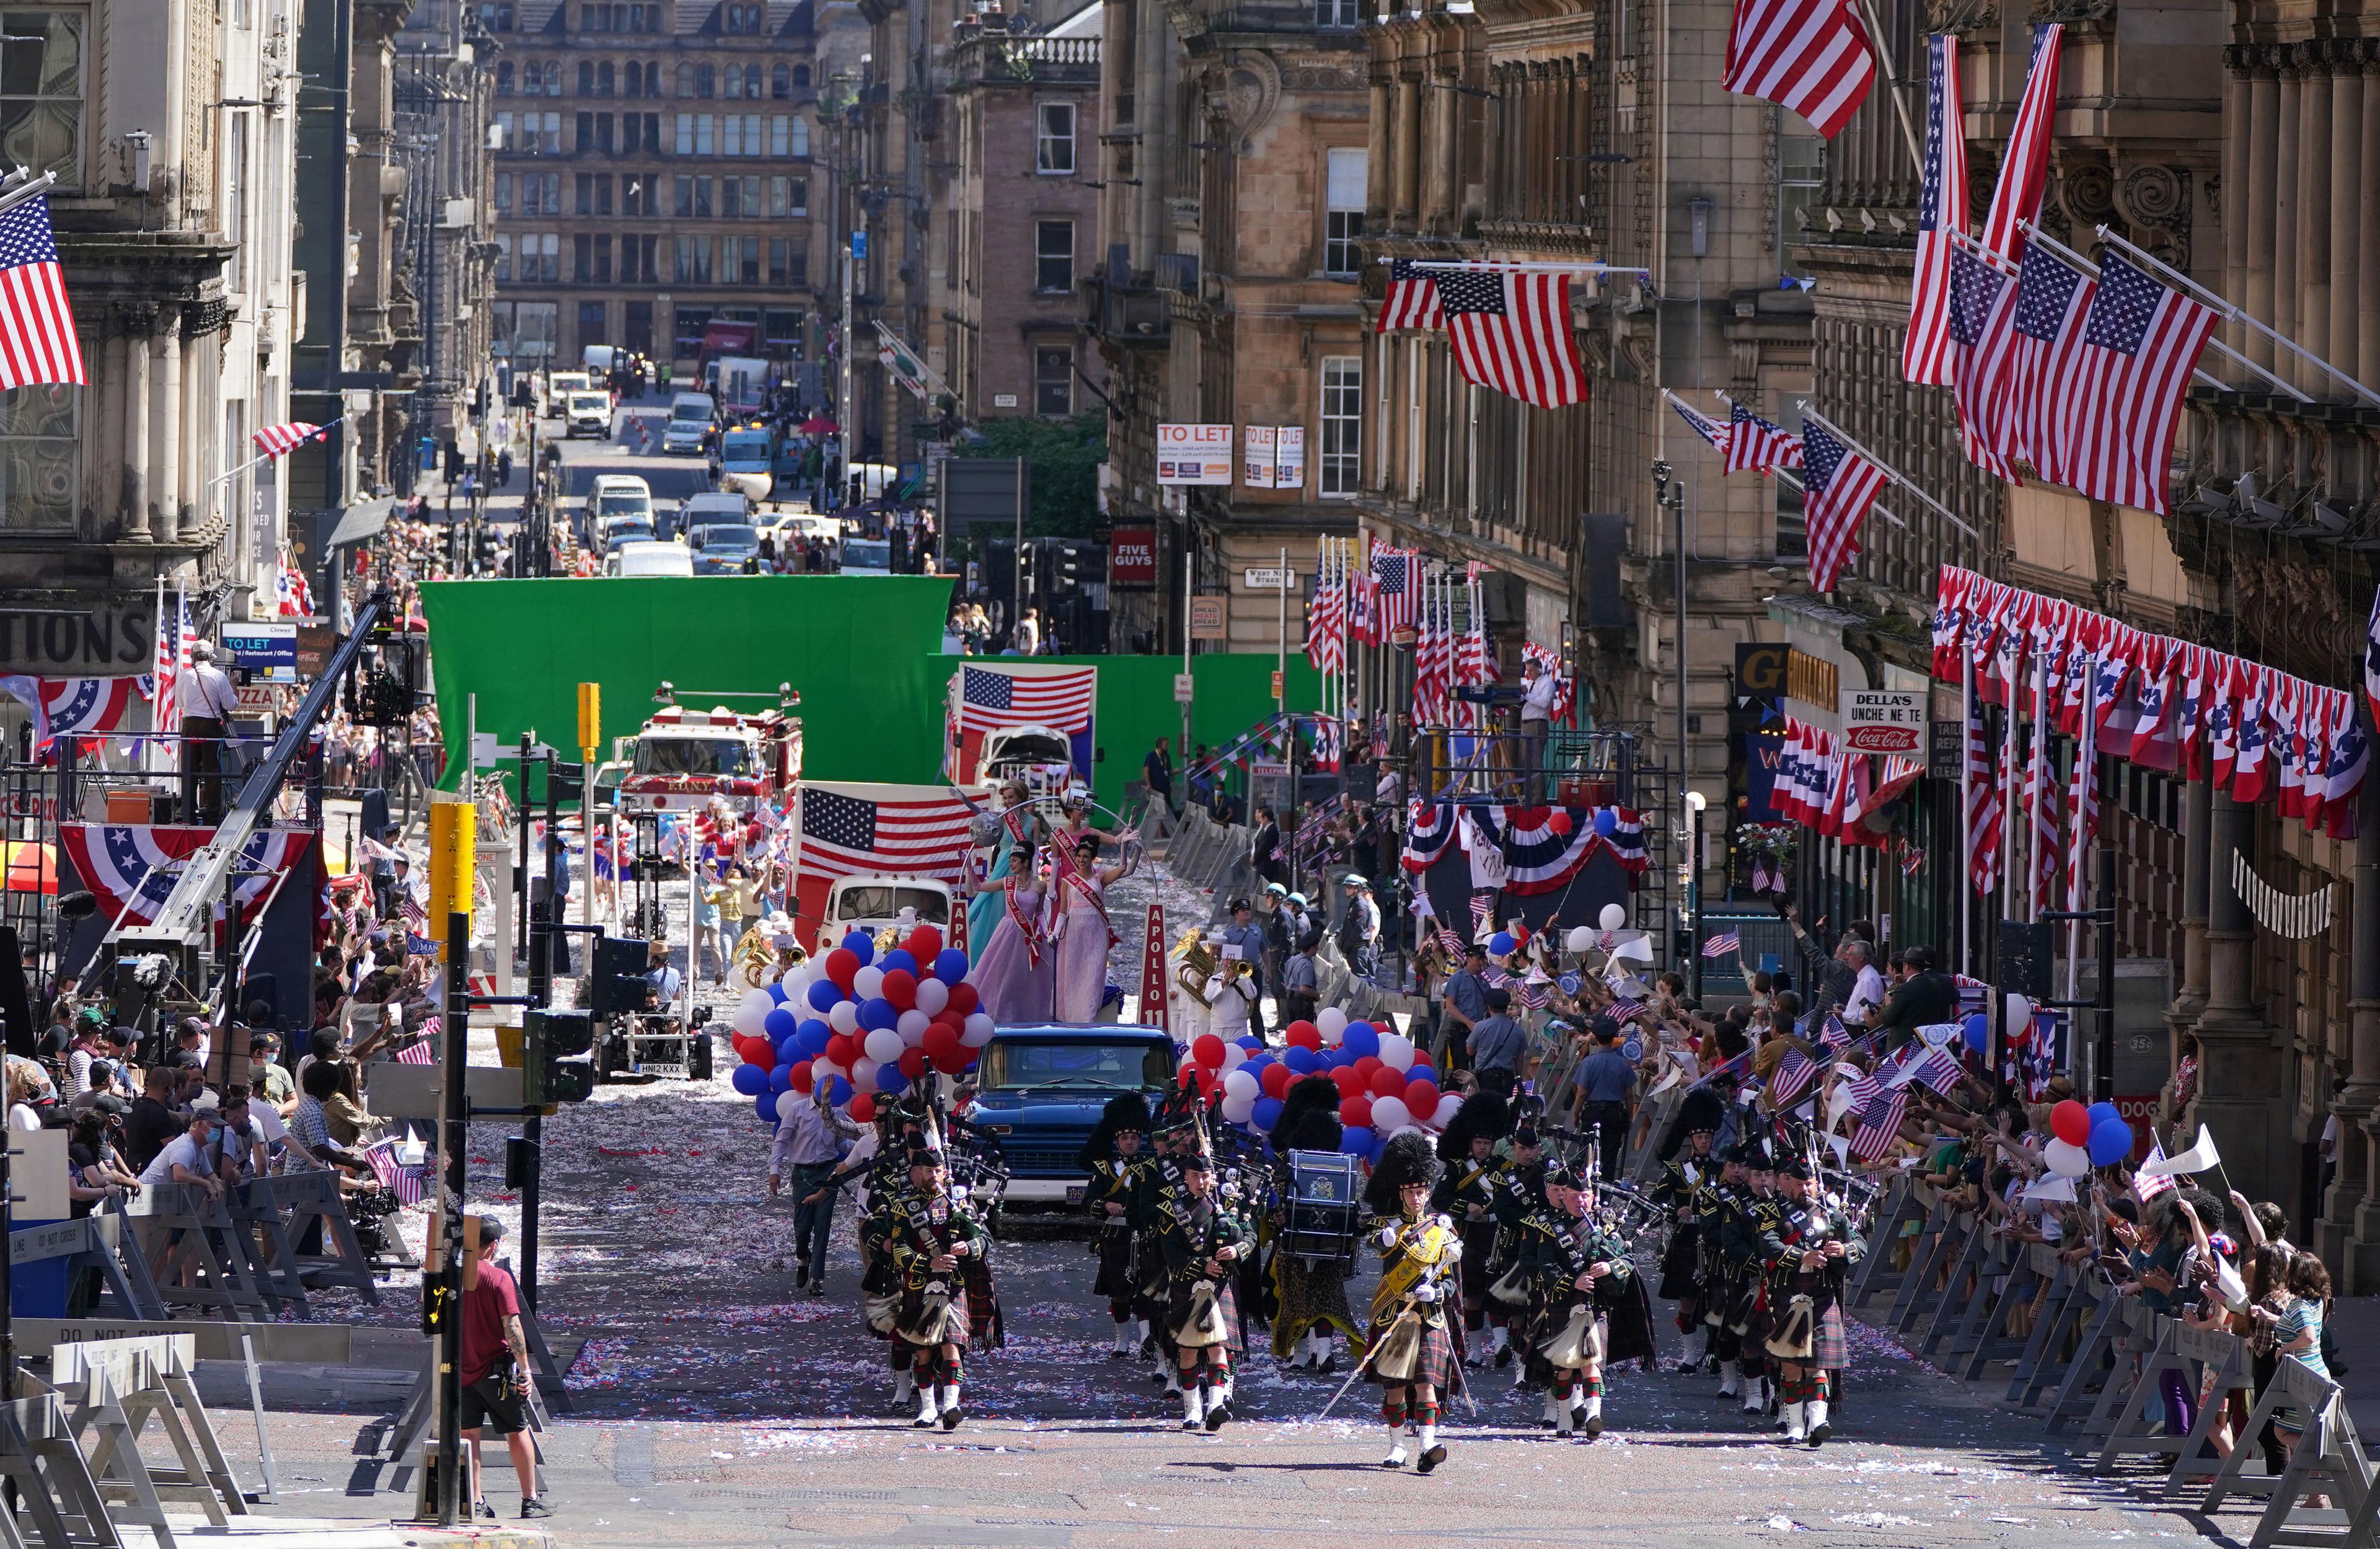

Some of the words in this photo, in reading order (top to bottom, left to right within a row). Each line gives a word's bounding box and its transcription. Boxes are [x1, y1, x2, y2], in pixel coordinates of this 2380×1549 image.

[1159, 426, 1188, 441] TO
[1194, 426, 1230, 442] LET
[1246, 428, 1257, 443] TO
[1259, 430, 1275, 444] LET
[1290, 430, 1303, 444] LET
[1118, 545, 1148, 555] FIVE
[1115, 555, 1152, 566] GUYS
[227, 639, 244, 650] TO
[248, 639, 270, 650] LET
[1742, 650, 1784, 689] G
[236, 689, 273, 704] IZZA
[1857, 695, 1912, 705] DELLA'S
[1852, 708, 1883, 721] UNCHE
[1890, 709, 1903, 722] NE
[1909, 709, 1921, 722] TE
[1937, 724, 1963, 735] TAILO
[1856, 728, 1911, 748] Coca-Cola
[1936, 738, 1963, 749] REPA
[1939, 755, 1952, 764] and
[1076, 880, 1088, 894] Long
[1085, 889, 1101, 908] Island
[1015, 910, 1027, 924] 1969
[954, 907, 964, 950] APO
[420, 942, 438, 951] MAN
[1150, 910, 1161, 1002] APOLLO
[1145, 1010, 1163, 1026] 11
[663, 1064, 680, 1073] KXX
[14, 1238, 25, 1252] LINE
[38, 1234, 46, 1247] DO
[48, 1231, 58, 1245] NOT
[60, 1229, 76, 1243] CROSS
[61, 1328, 81, 1343] DO
[95, 1329, 126, 1341] NOT
